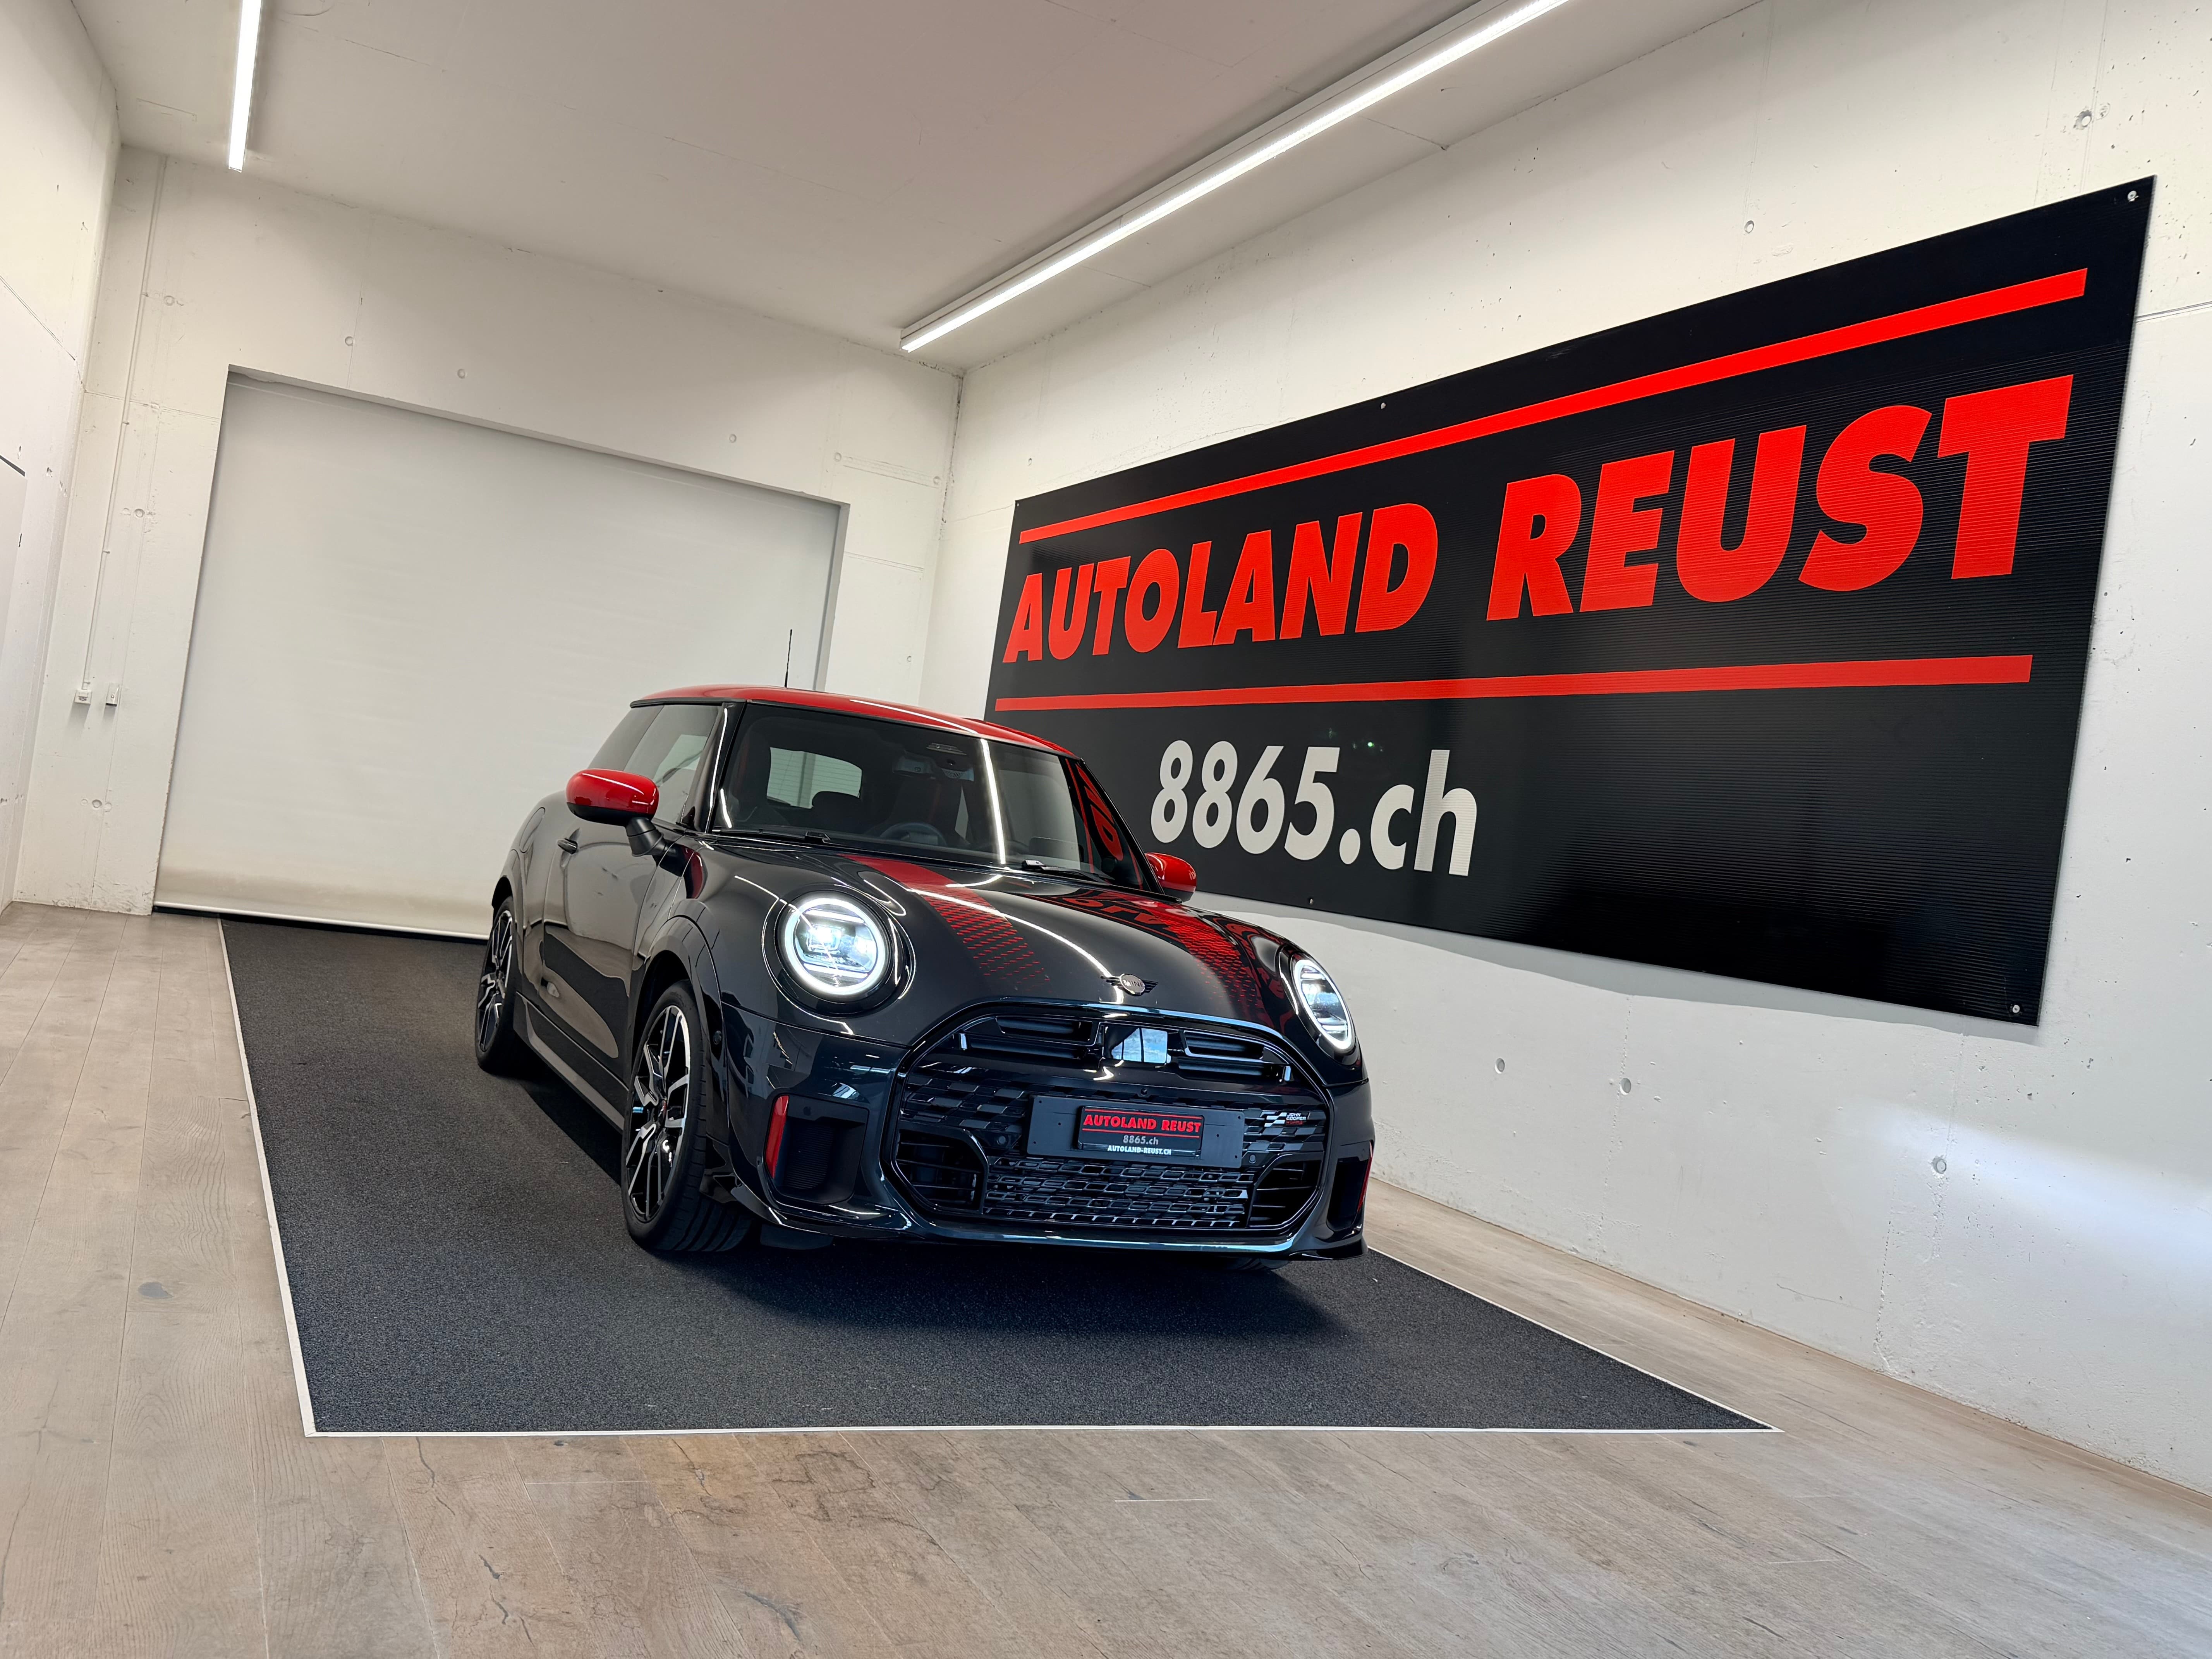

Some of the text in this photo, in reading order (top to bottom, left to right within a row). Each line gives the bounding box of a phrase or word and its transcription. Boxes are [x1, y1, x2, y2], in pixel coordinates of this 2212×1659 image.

[1004, 375, 2073, 664] AUTOLAND REUST
[1151, 740, 1477, 876] 8865.ch
[1083, 1115, 1201, 1132] AUTOLAND REUST
[1123, 1135, 1158, 1145] 8865.ch
[1108, 1145, 1171, 1155] AUTOLAND-REUST.CH
